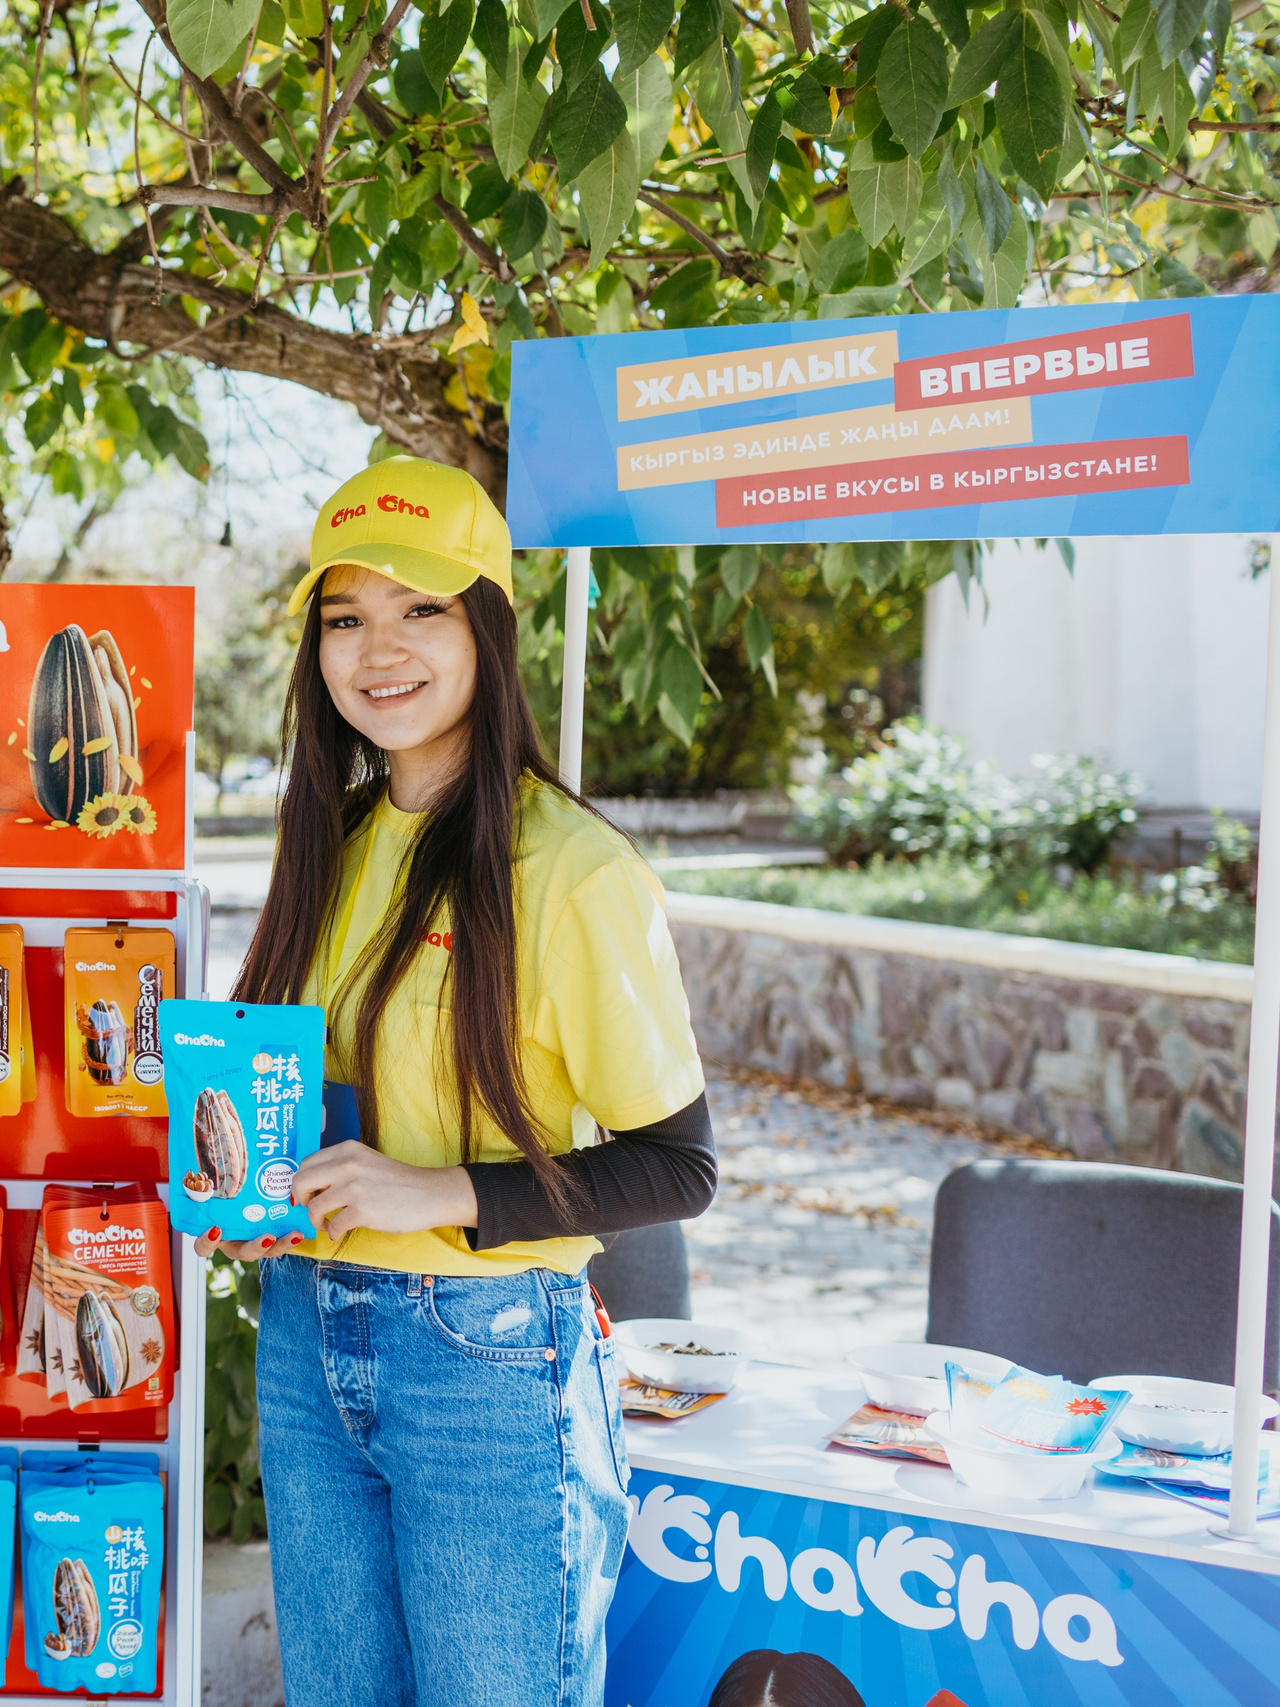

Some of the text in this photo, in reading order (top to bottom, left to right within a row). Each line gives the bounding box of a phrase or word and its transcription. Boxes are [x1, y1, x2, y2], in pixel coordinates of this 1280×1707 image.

[920, 337, 1150, 398] ВПЕРВЫЕ
[630, 408, 1010, 472] КЫРГЫЗ ЭДИНДЕ ЖАҢЫ ДААМ!
[743, 454, 1157, 507] НОВЫЕ ВКУСЫ В КЫРГЫЗСТАНЕ!
[331, 494, 430, 528] Cha Cha
[75, 961, 116, 972] ChaCha
[138, 965, 156, 1051] Семечки
[174, 1032, 225, 1047] ChaCha
[67, 1224, 145, 1245] ChaCha
[74, 1242, 146, 1260] СЕМЕЧКИ
[33, 1510, 80, 1523] ChaCha
[628, 1483, 1125, 1668] ChaCha
